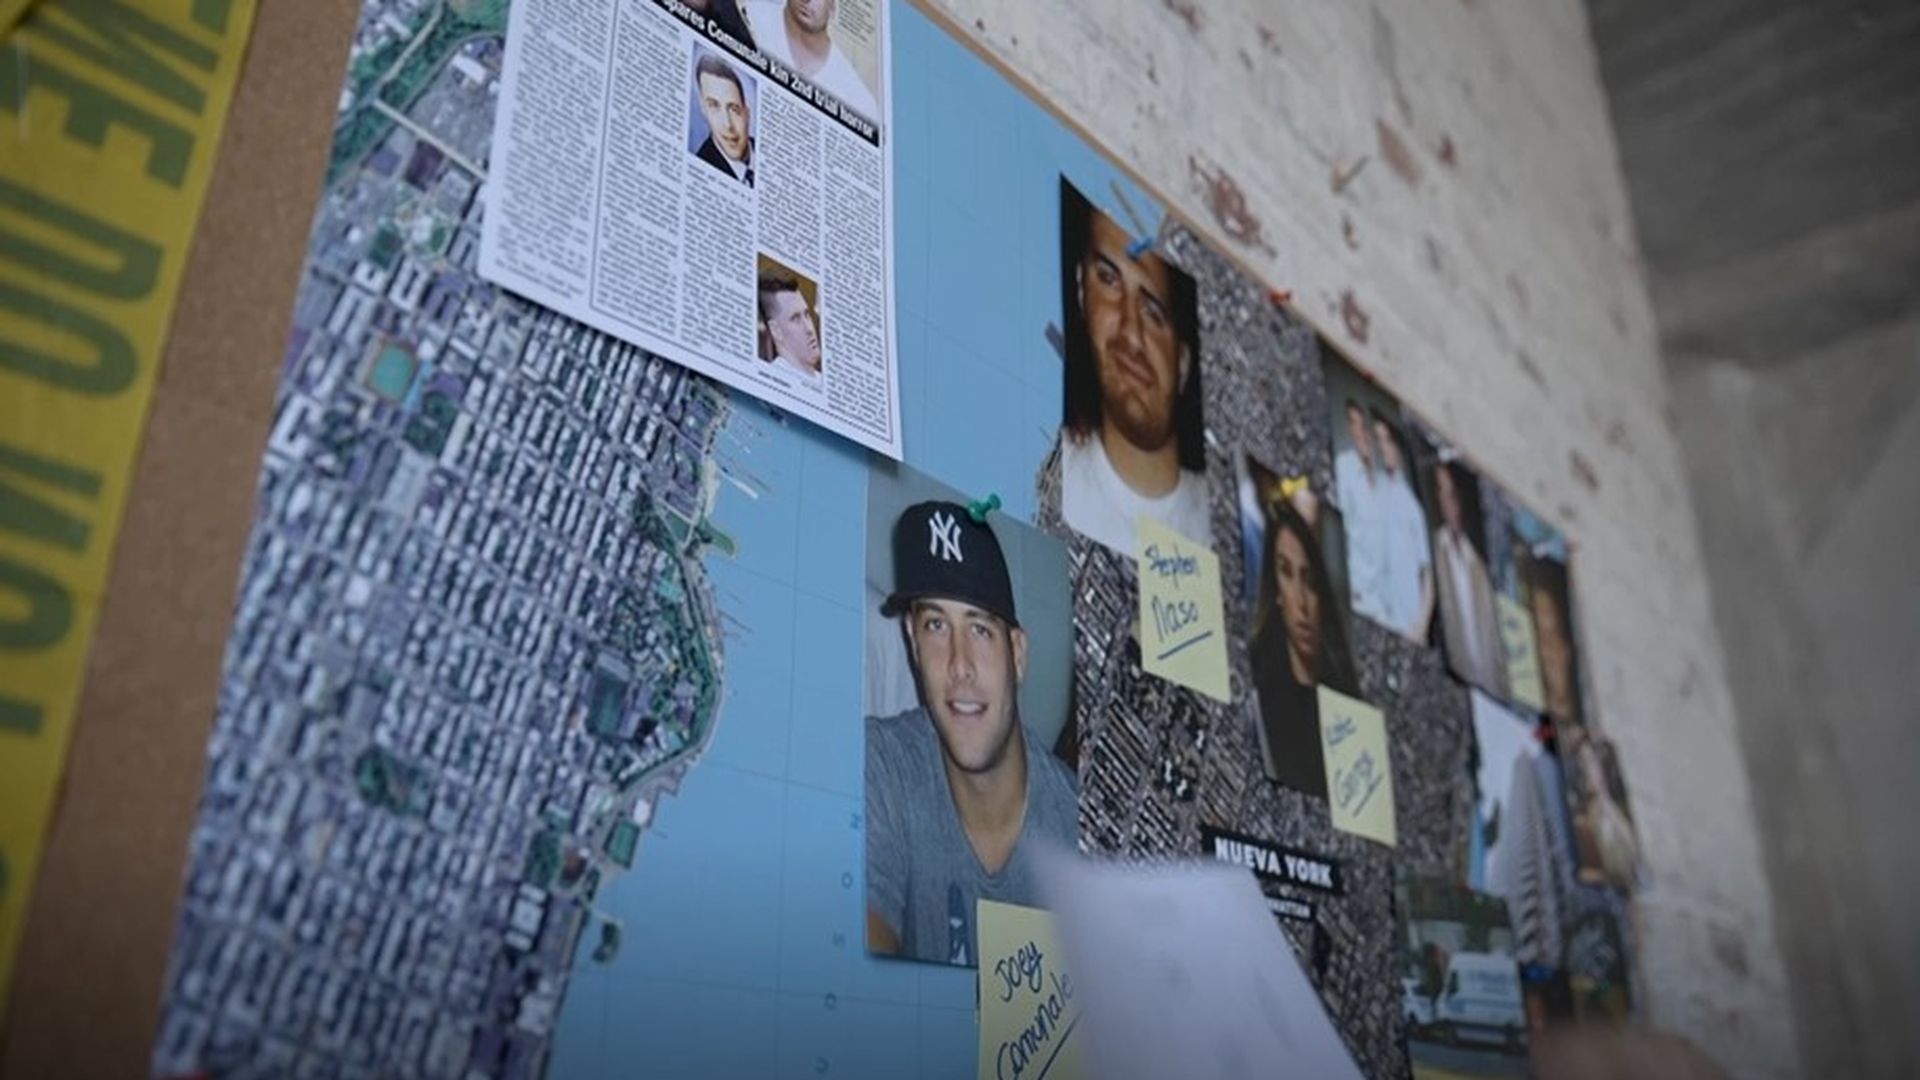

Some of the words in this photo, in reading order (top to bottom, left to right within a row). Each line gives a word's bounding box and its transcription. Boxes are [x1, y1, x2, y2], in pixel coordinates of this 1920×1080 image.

[771, 60, 789, 85] kin
[790, 73, 812, 100] 2nd
[815, 89, 838, 116] trial
[928, 510, 963, 563] NY
[1214, 836, 1282, 876] NUEVA
[1284, 854, 1333, 889] YORK
[994, 940, 1045, 1003] Joey
